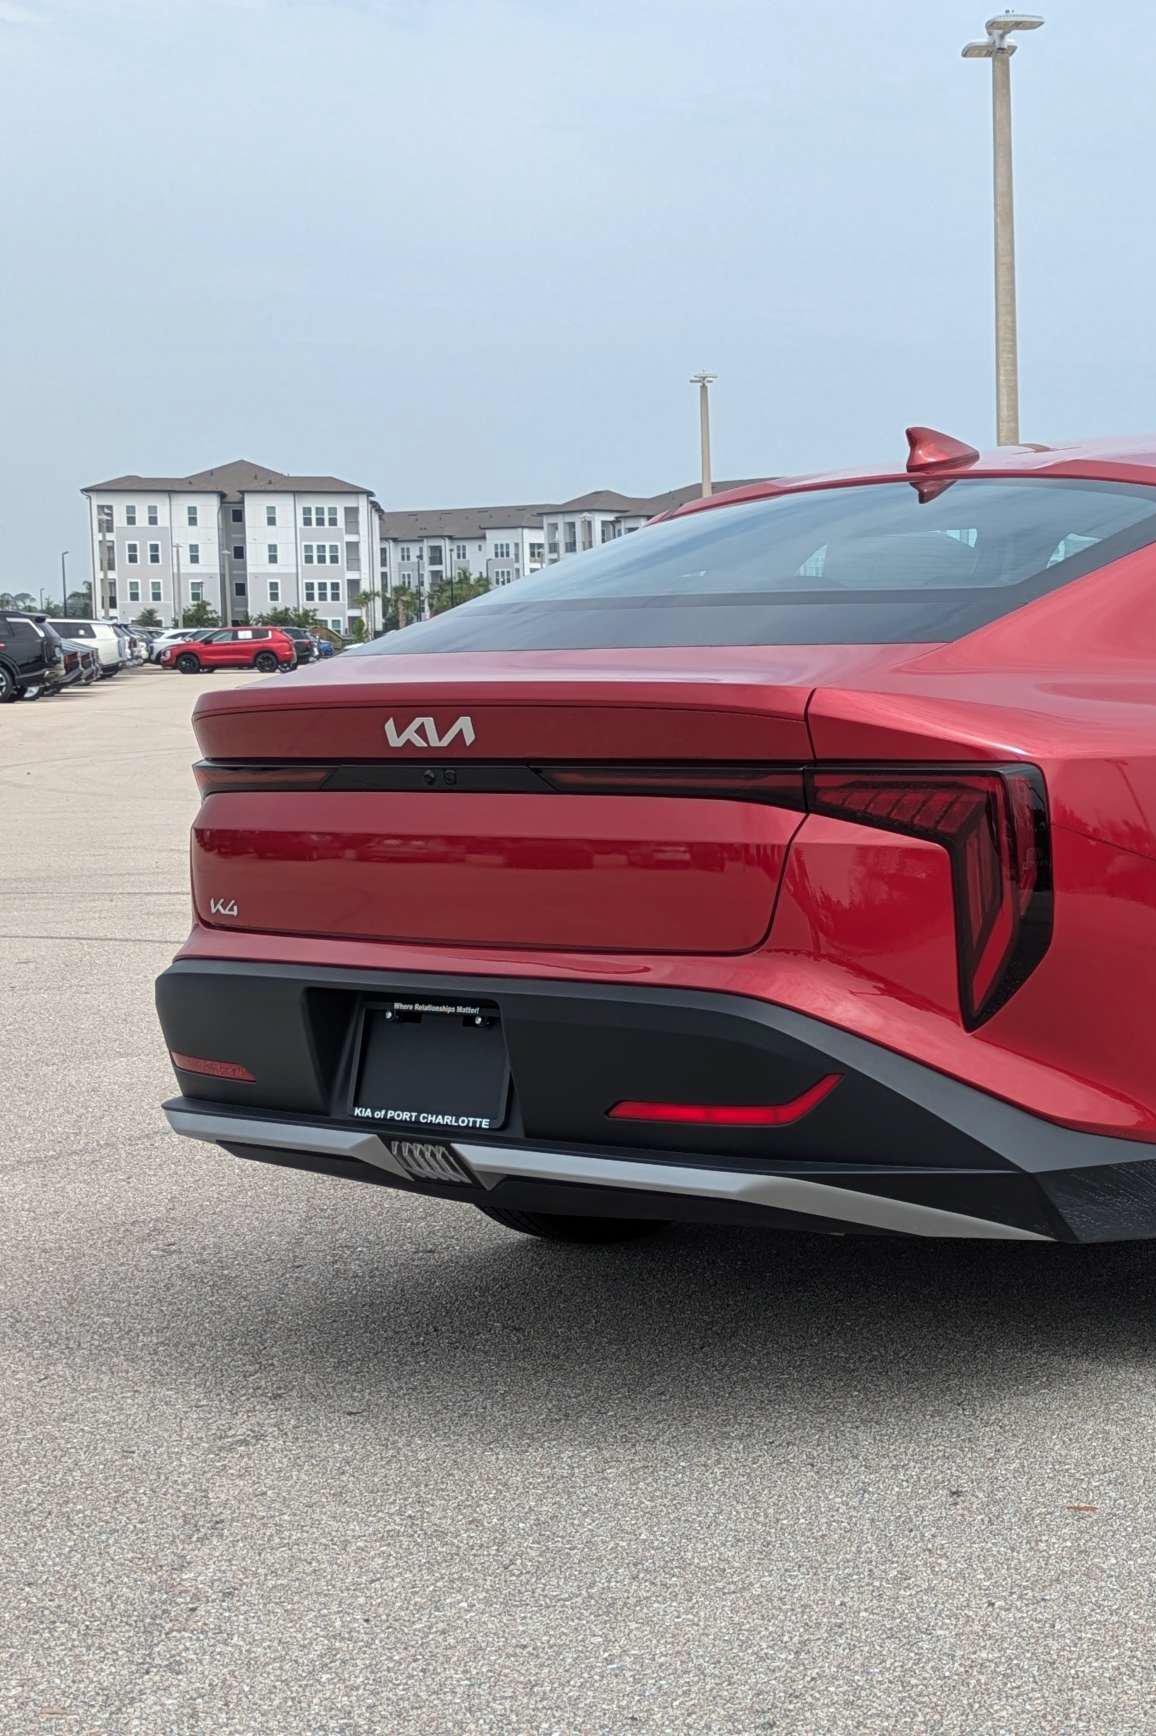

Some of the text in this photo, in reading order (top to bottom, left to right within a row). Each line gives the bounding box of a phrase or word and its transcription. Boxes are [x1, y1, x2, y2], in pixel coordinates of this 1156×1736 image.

[384, 716, 476, 747] KIA
[210, 897, 238, 917] K4
[394, 1002, 413, 1011] Where
[414, 1003, 455, 1014] Relationships
[354, 1107, 490, 1128] KIA of PORT CHARLOTTE
